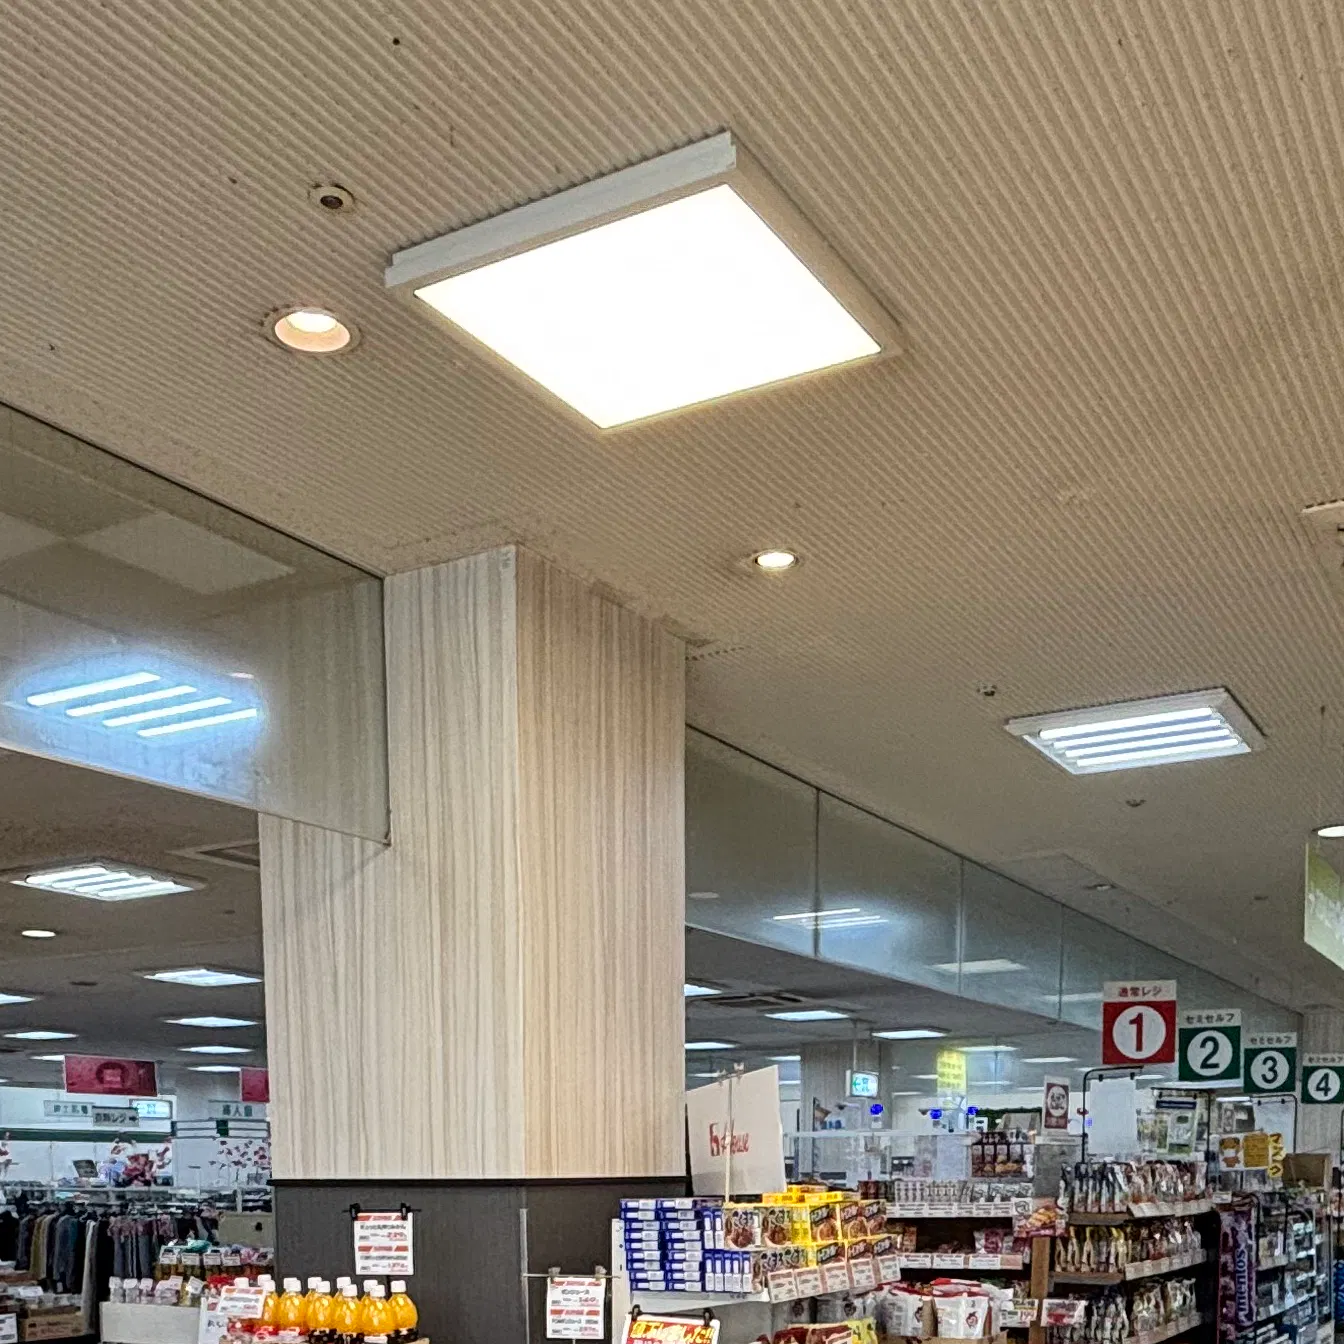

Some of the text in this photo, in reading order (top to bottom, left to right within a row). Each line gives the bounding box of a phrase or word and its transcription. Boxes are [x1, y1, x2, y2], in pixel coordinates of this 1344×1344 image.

[1129, 1012, 1144, 1052] 1
[1185, 1013, 1235, 1025] セミセルフ
[1199, 1036, 1220, 1069] 2
[1261, 1056, 1278, 1083] 3
[1314, 1072, 1331, 1096] 4
